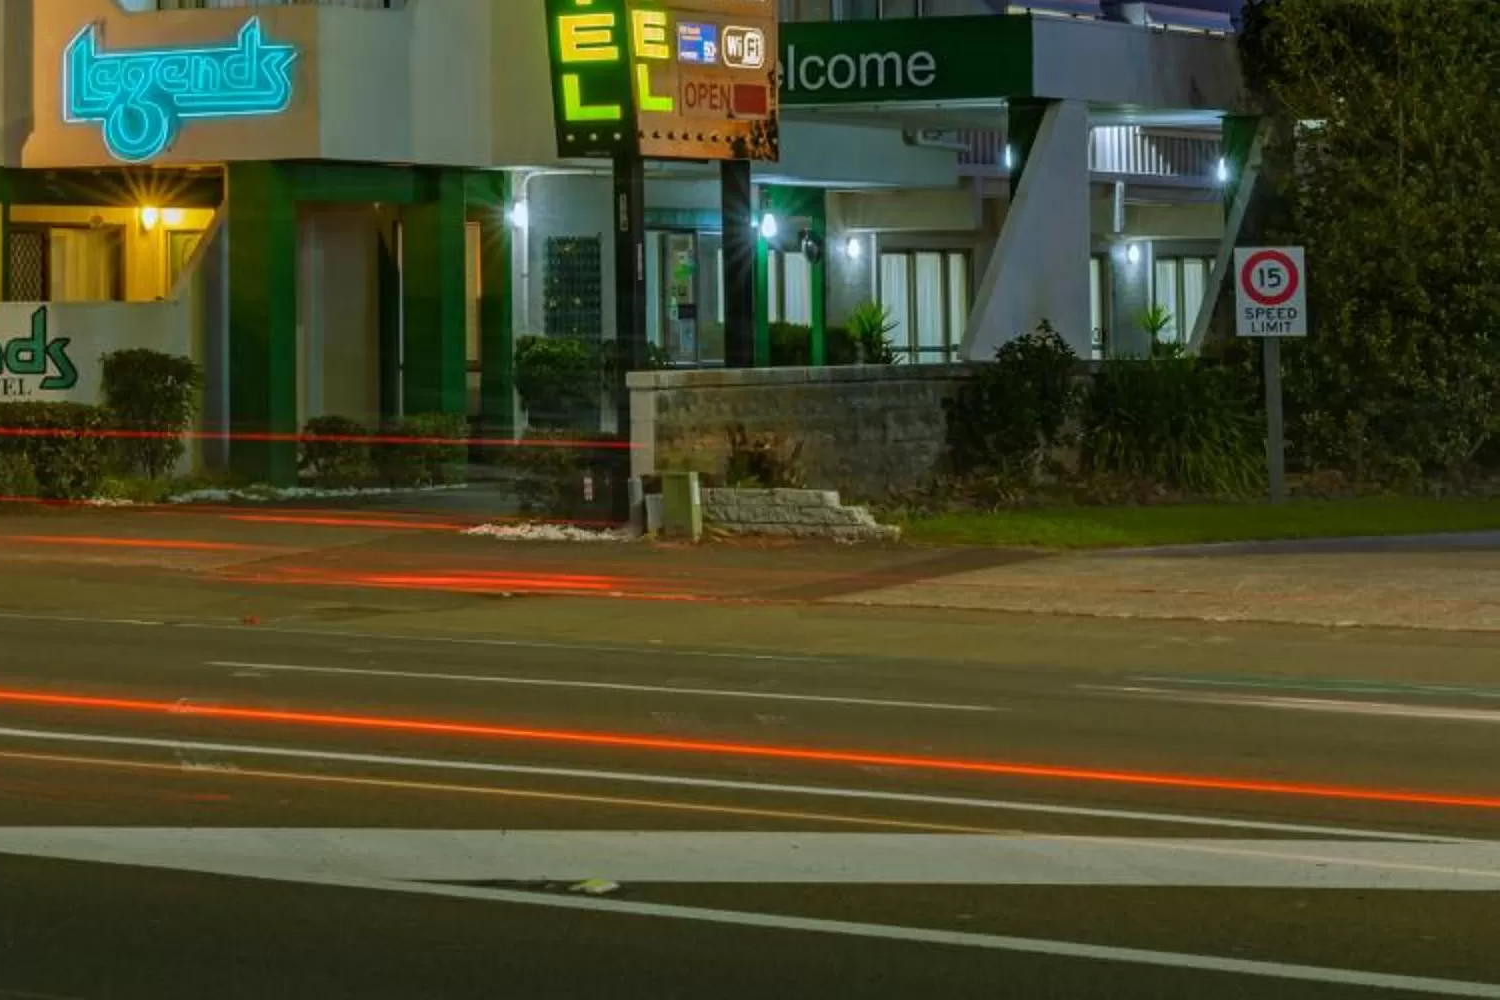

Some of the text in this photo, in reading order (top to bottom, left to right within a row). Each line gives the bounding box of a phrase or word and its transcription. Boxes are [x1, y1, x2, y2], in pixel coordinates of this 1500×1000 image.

[776, 44, 937, 91] lcome
[63, 16, 298, 163] Legends
[684, 81, 732, 110] OPEN
[1259, 267, 1282, 288] 15
[1244, 307, 1297, 320] SPEED
[1251, 321, 1293, 333] LIMIT
